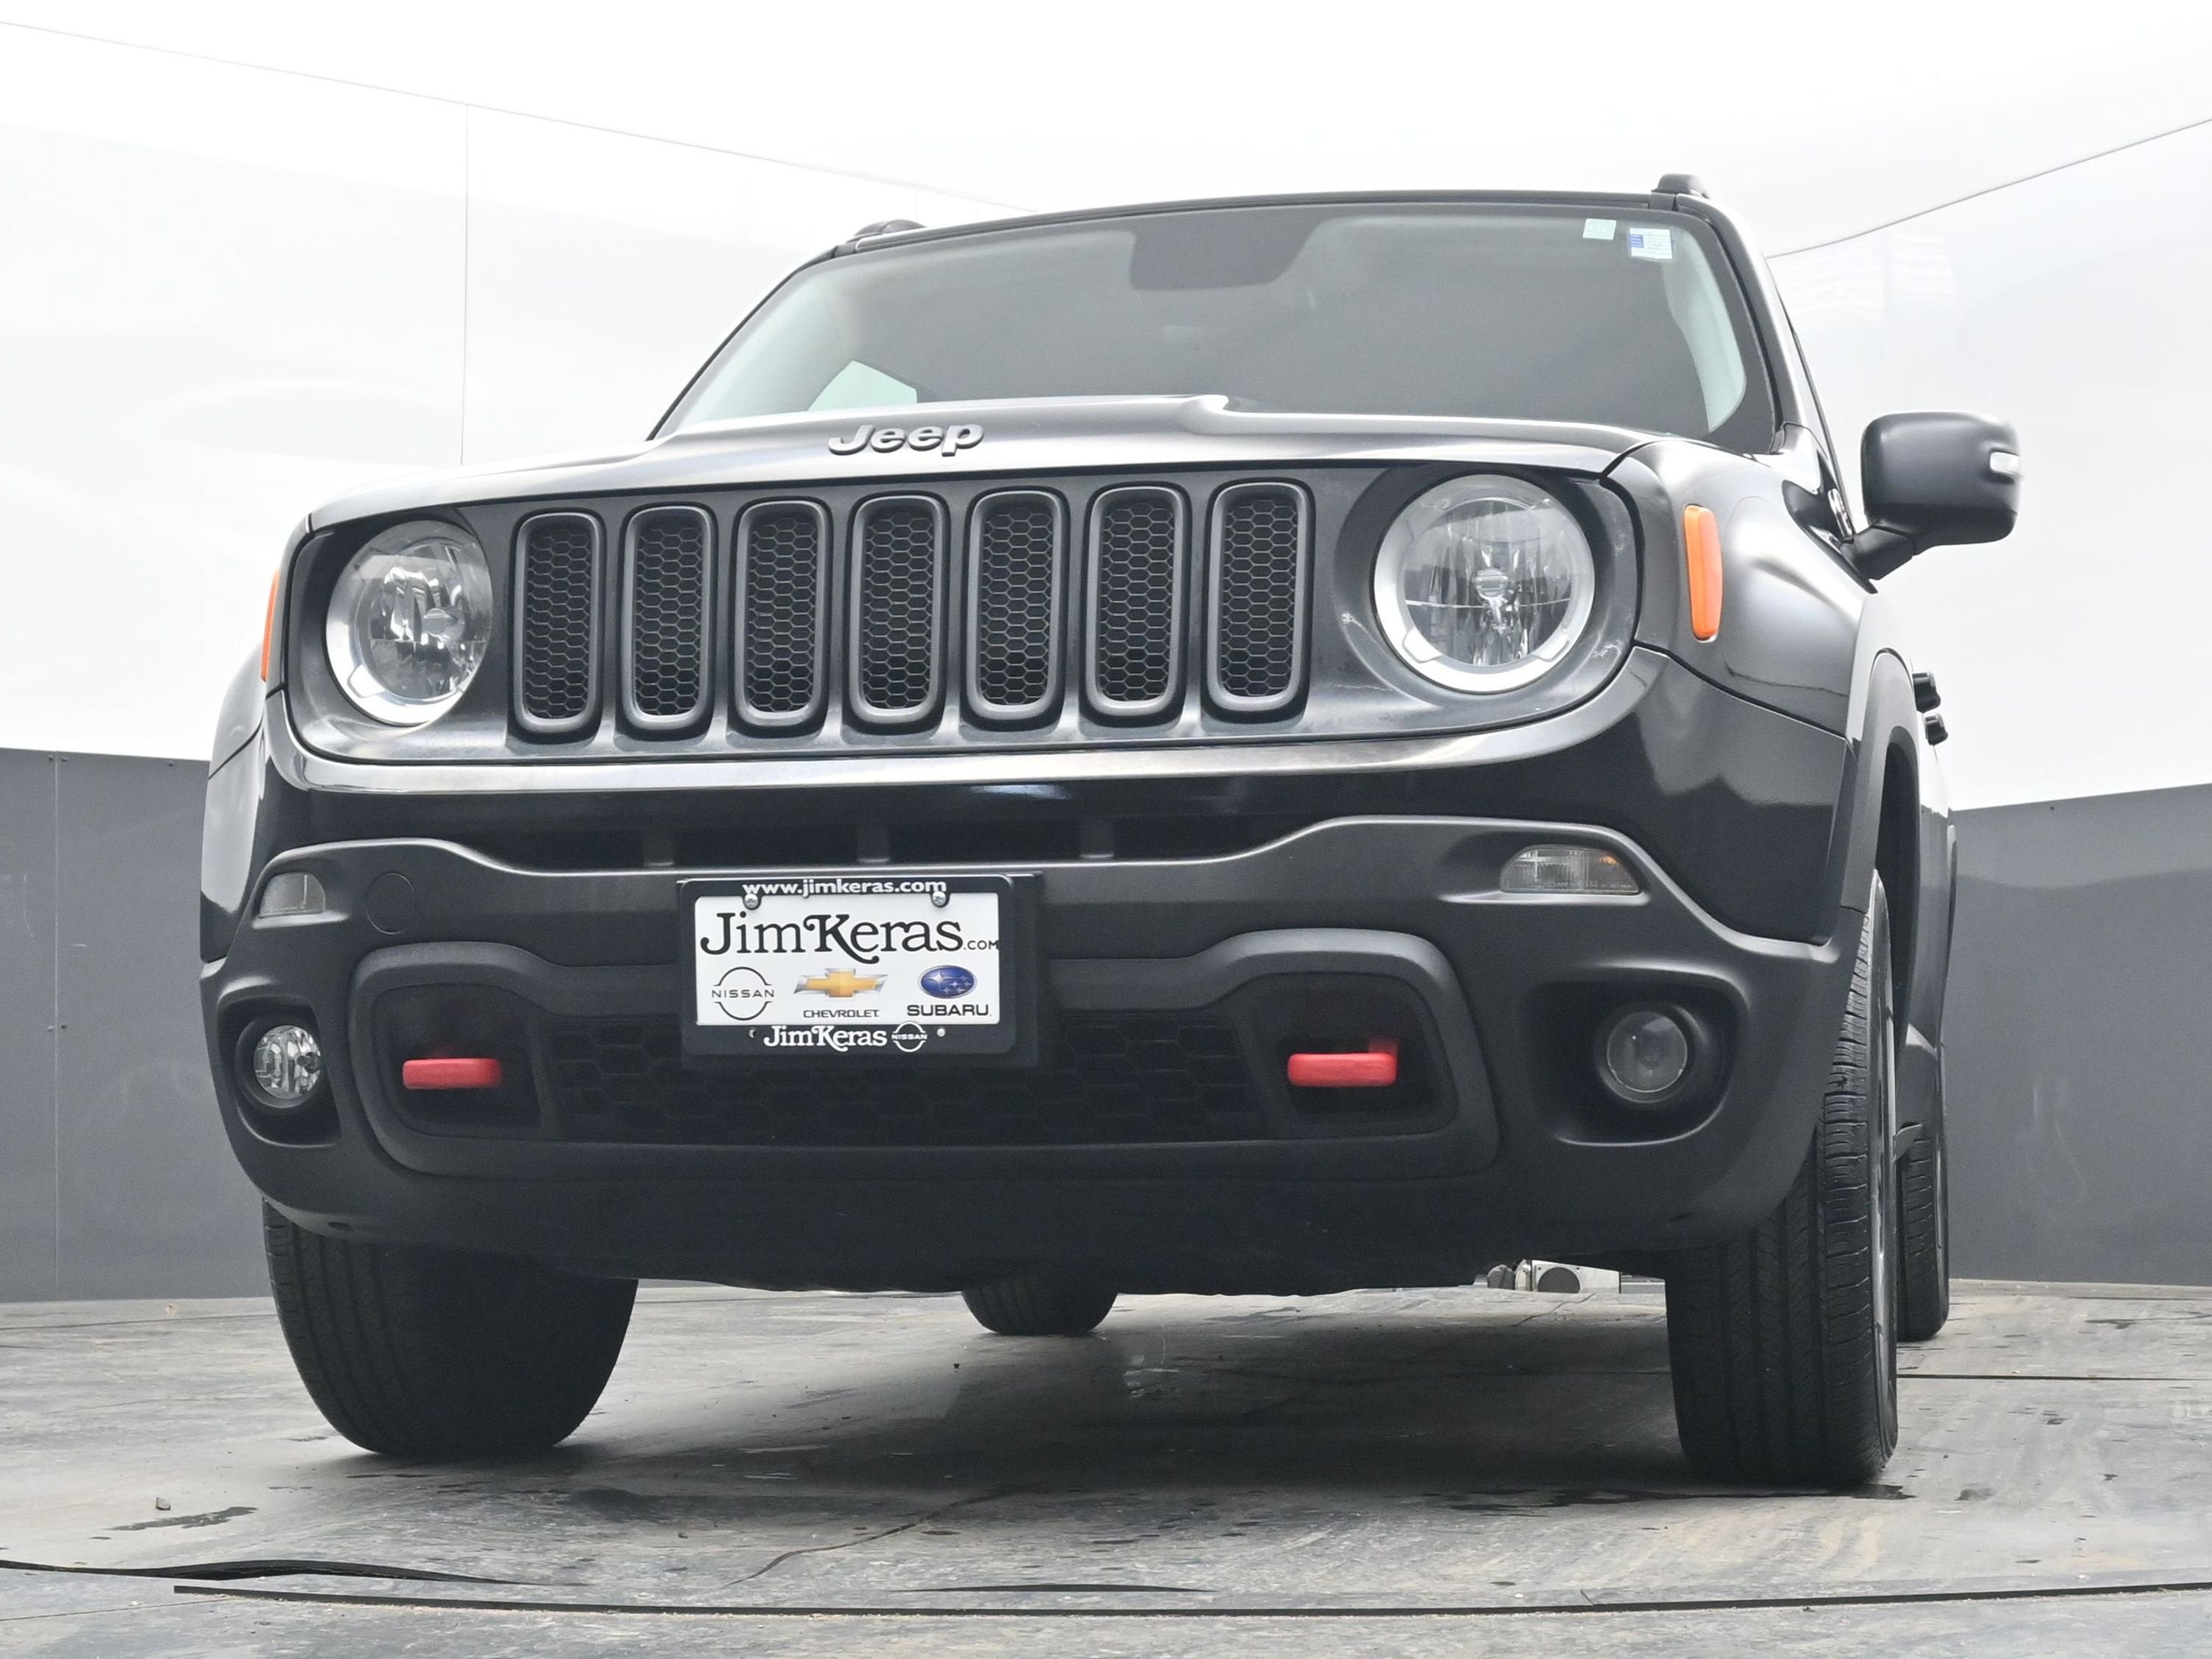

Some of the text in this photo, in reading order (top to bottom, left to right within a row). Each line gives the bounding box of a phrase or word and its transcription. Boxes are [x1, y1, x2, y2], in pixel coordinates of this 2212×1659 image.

[827, 423, 984, 457] Jeep
[742, 877, 947, 898] www.jimkeras.com
[711, 989, 775, 998] NISSAN
[803, 1009, 880, 1018] CHEVROLET
[906, 1004, 990, 1017] SUBARU
